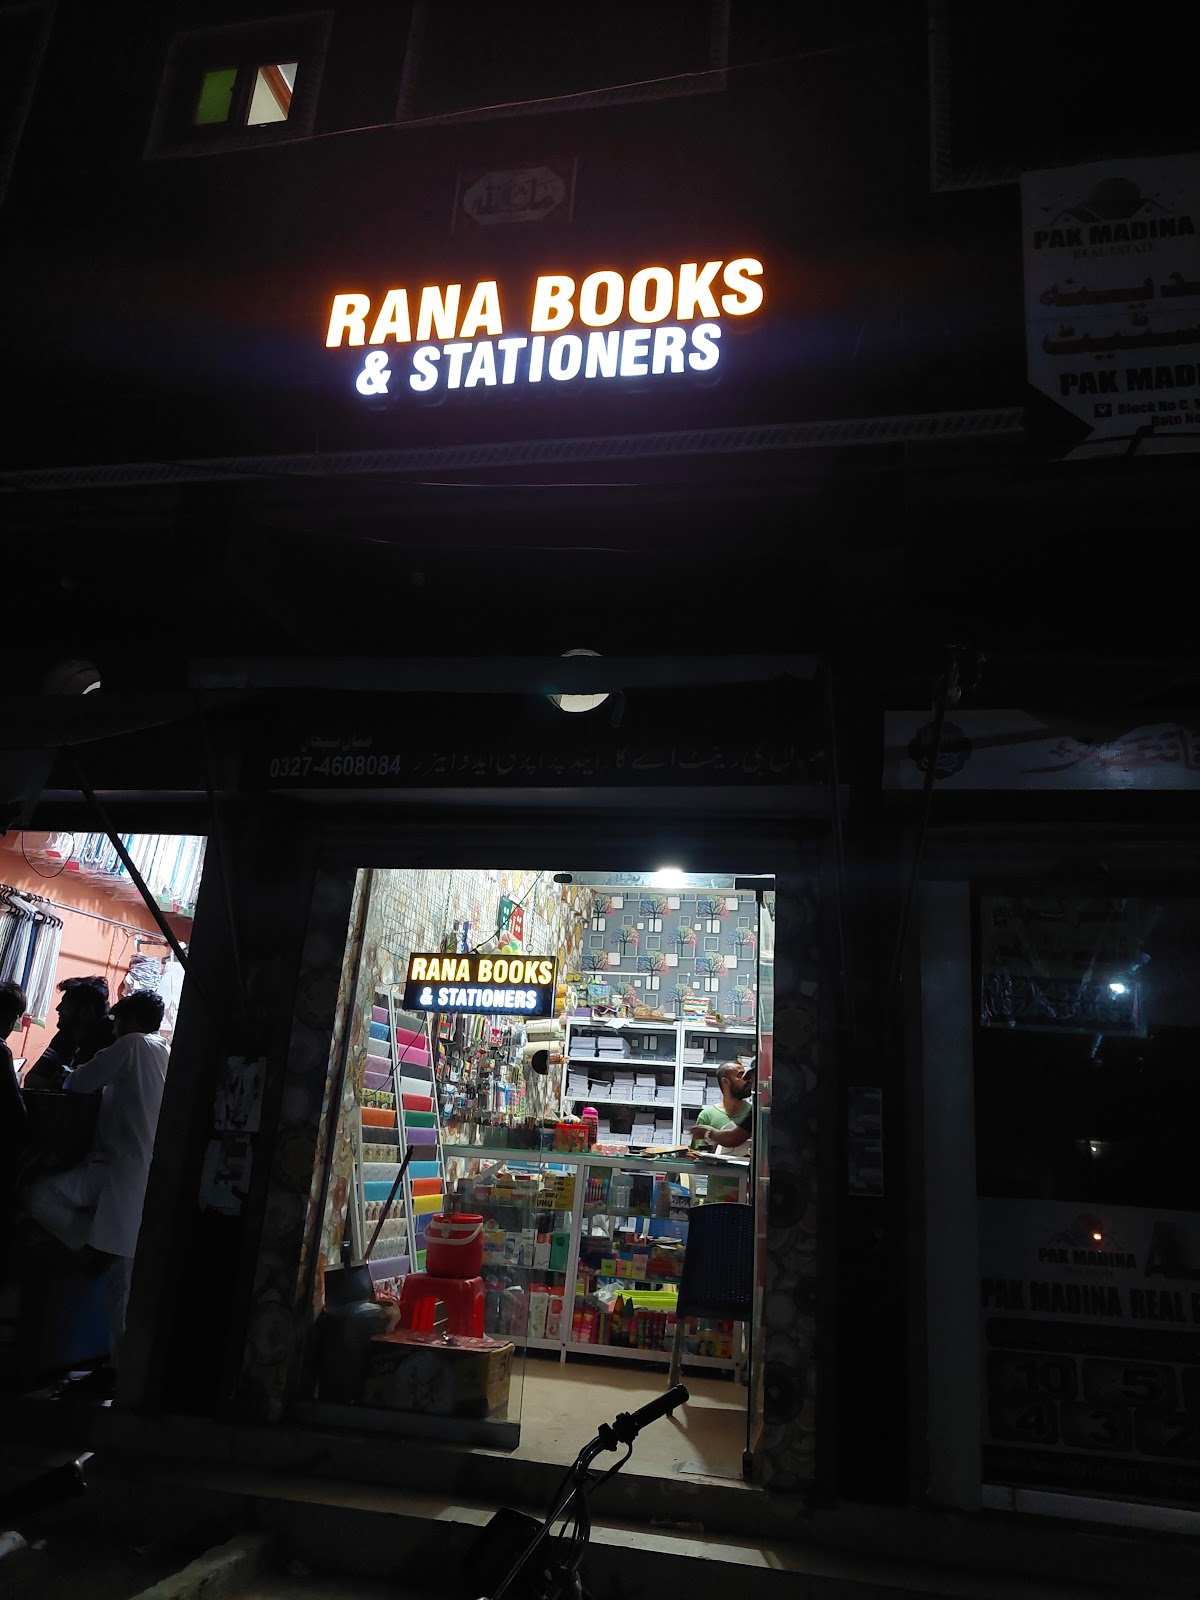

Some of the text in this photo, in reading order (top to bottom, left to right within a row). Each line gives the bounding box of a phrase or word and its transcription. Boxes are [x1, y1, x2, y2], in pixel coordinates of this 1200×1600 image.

[1034, 216, 1195, 249] PAK MADINA
[325, 257, 764, 348] RANA BOOKS
[355, 323, 722, 396] & STATIONERS
[1060, 371, 1119, 396] PAK
[1118, 401, 1156, 415] Block
[1158, 400, 1177, 413] No
[269, 754, 401, 778] 0327-4608084
[411, 957, 553, 985] RANA BOOKS
[419, 986, 537, 1009] & STATIONERS
[1038, 1248, 1137, 1268] PAK MADINA
[982, 1279, 1025, 1309] PAK
[1031, 1281, 1122, 1316] MADINA
[1129, 1287, 1186, 1323] REAL
